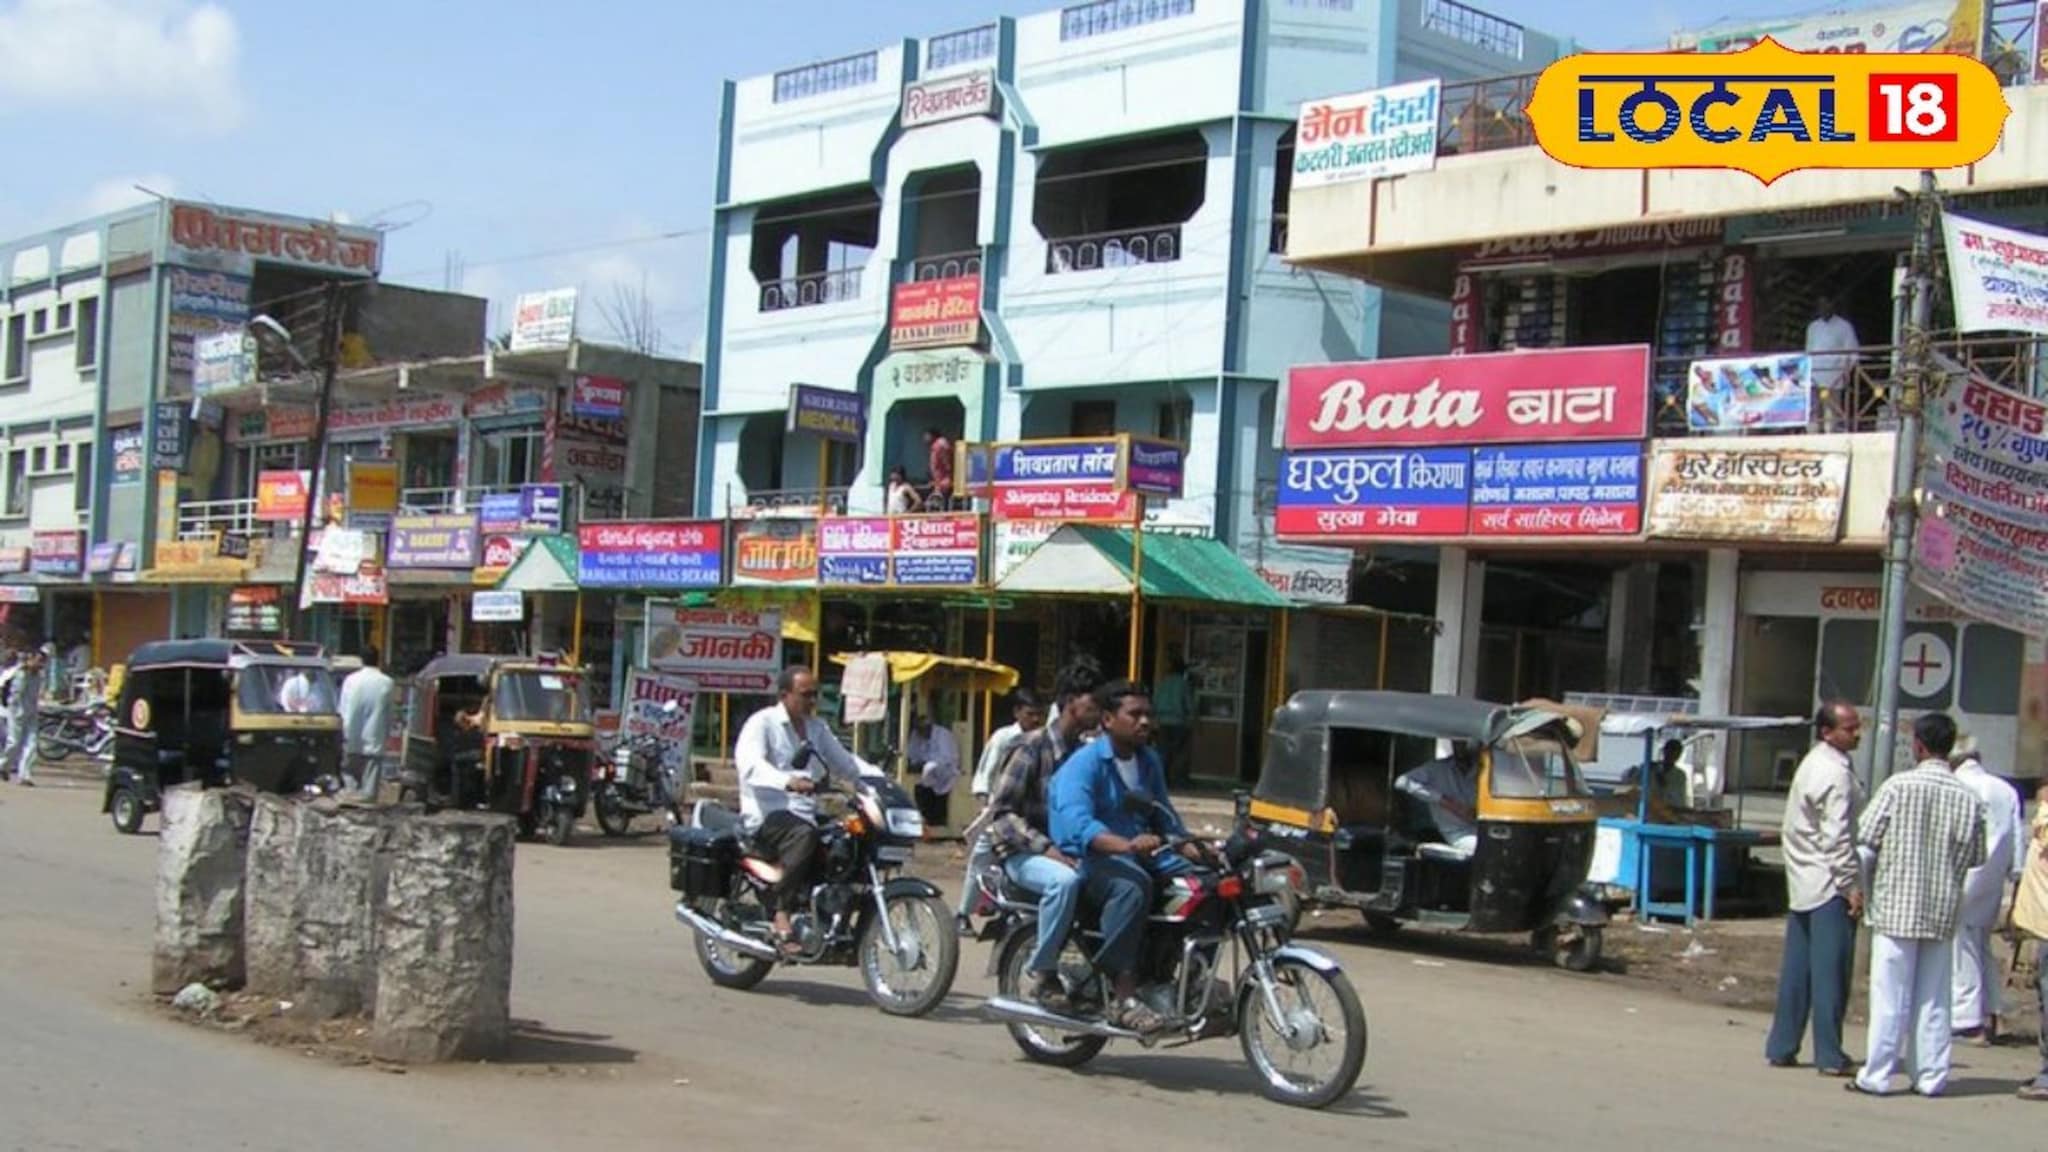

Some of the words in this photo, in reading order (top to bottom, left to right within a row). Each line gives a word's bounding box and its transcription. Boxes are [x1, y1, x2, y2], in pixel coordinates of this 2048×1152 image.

[1303, 105, 1367, 143] जैन
[1309, 378, 1484, 433] Bata
[1507, 386, 1616, 426] बाटा
[1013, 449, 1079, 476] शिवप्रताप
[1082, 447, 1114, 472] लॉज
[1288, 454, 1405, 505] घरकुल
[1820, 587, 1881, 611] दवाखा
[678, 631, 775, 661] जानकी
